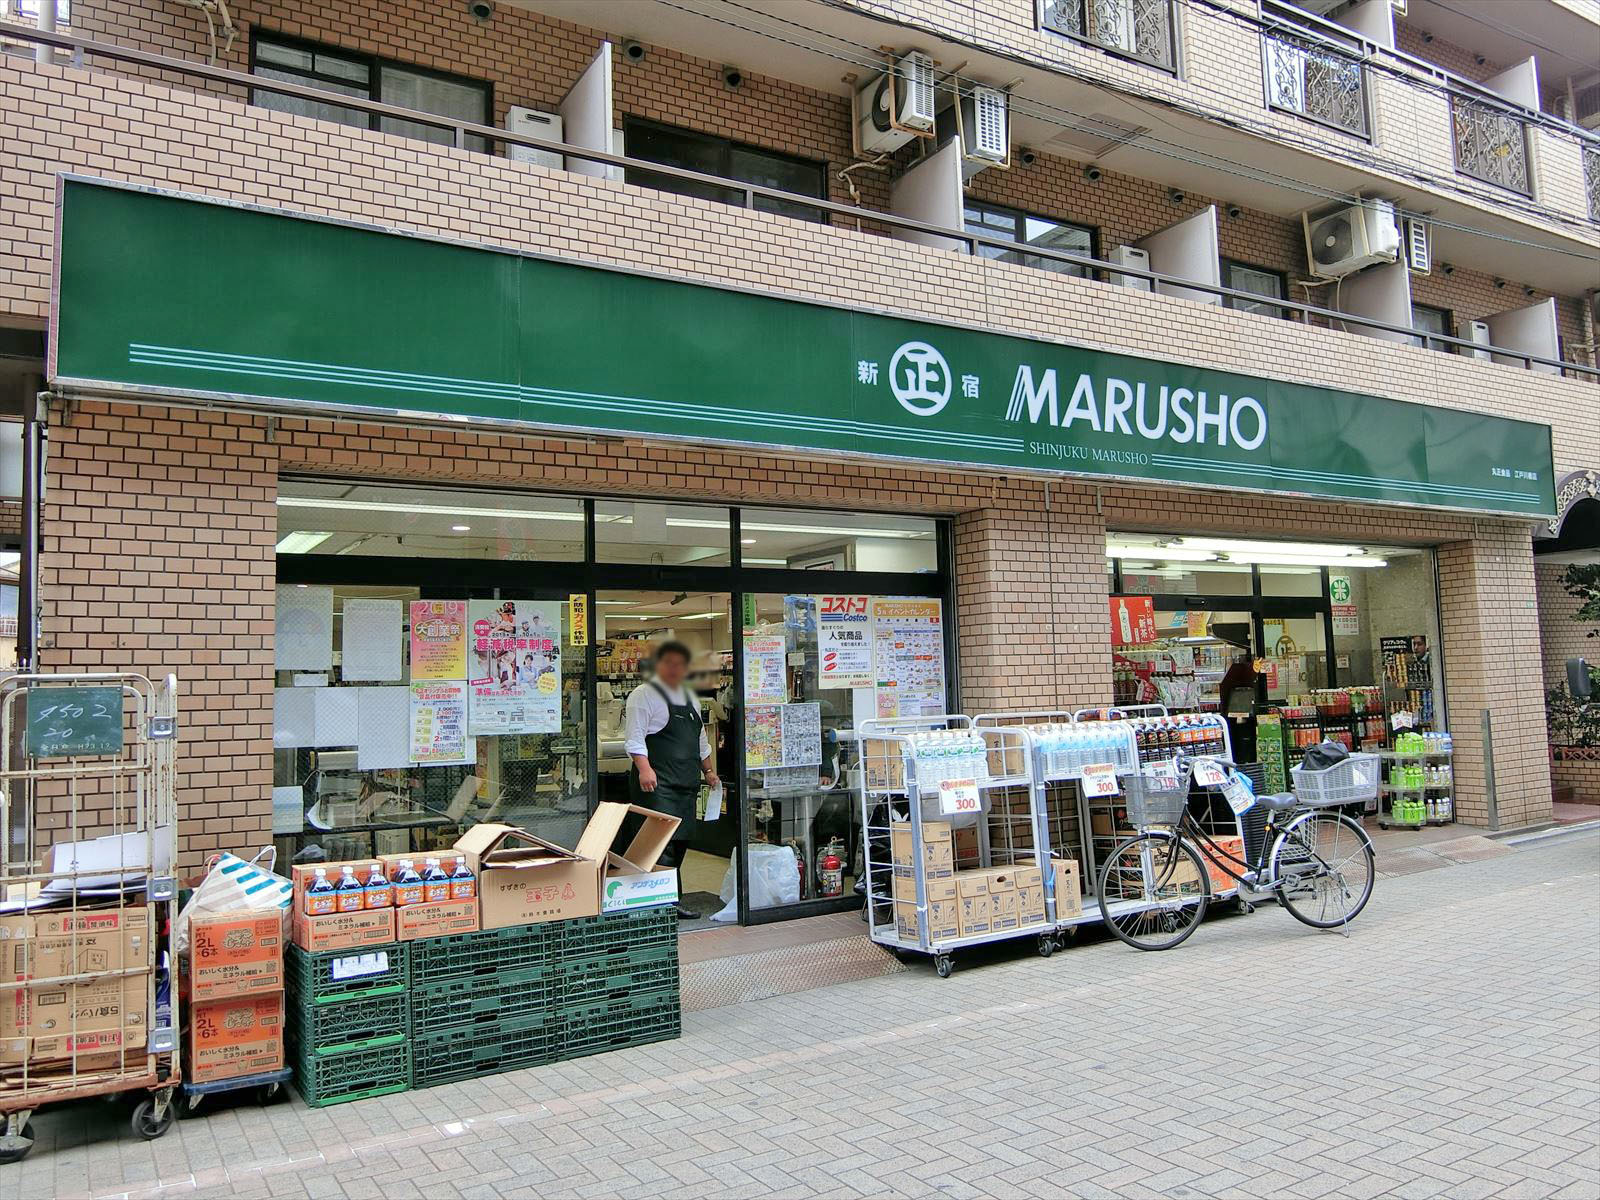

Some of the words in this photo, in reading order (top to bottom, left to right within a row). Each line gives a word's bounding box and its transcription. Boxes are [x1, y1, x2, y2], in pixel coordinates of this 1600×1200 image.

[857, 359, 879, 386] 新
[961, 374, 980, 399] 宿
[1004, 363, 1268, 451] MARUSHO
[1029, 441, 1089, 461] SHINJUKU
[1092, 448, 1149, 467] MARUSHO
[820, 597, 868, 613] コストコ
[843, 613, 868, 622] Costco
[828, 630, 863, 641] 人気商品
[476, 638, 555, 651] 軽減税率制度
[1206, 771, 1222, 783] 128
[1096, 782, 1114, 793] 300
[955, 798, 976, 810] 300
[525, 886, 560, 904] 玉子
[196, 937, 215, 949] 2L
[196, 1018, 216, 1029] 2L
